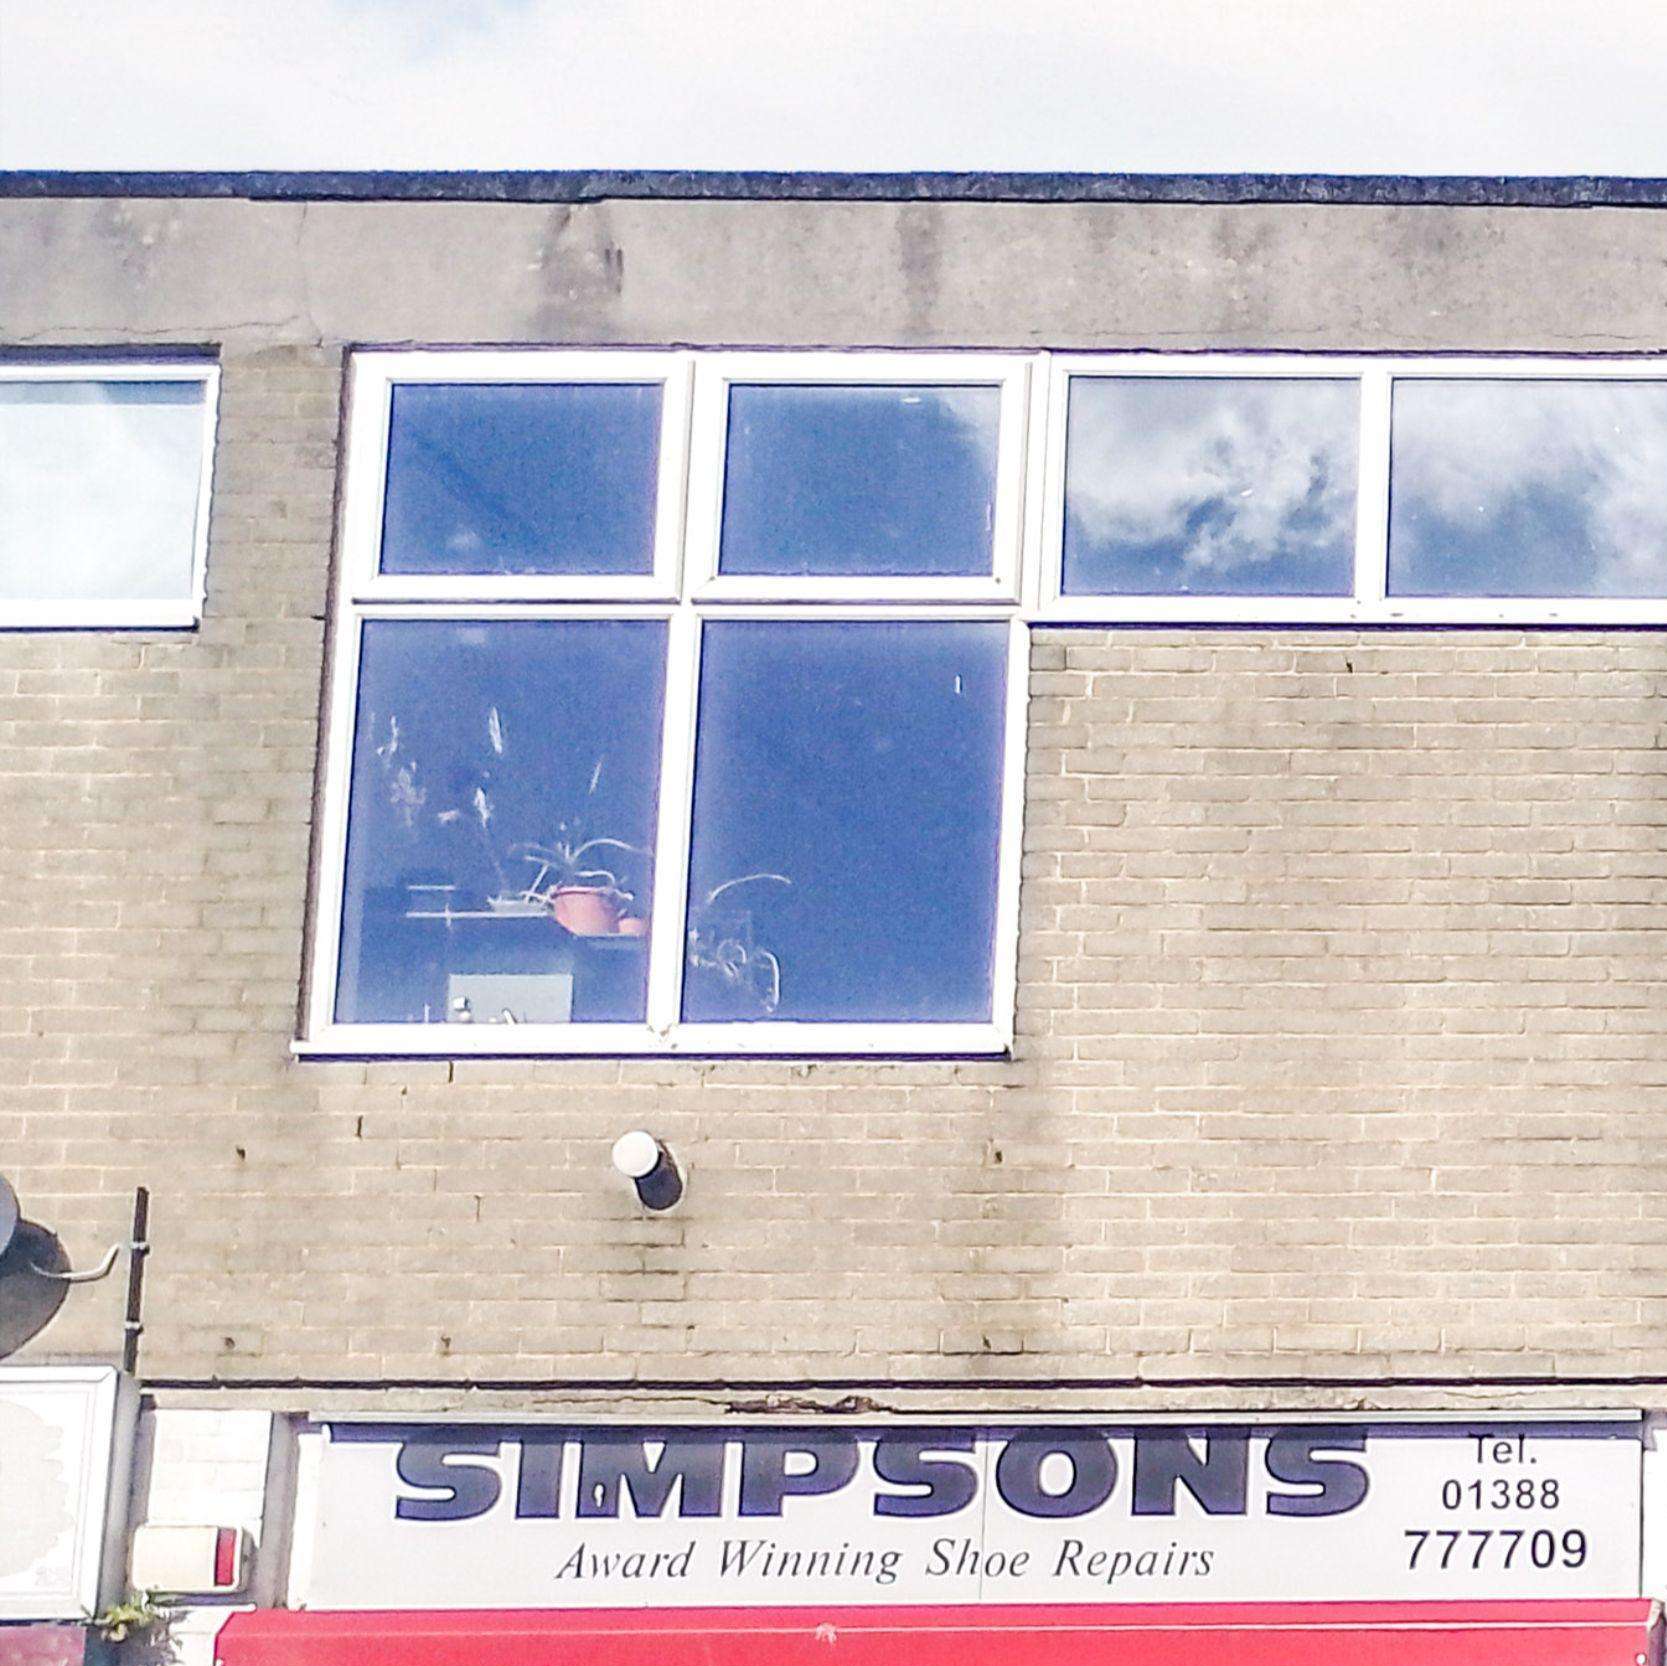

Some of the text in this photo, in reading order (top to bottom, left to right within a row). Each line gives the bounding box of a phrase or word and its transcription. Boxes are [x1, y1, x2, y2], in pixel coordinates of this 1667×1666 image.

[1467, 1433, 1537, 1464] Tel.
[395, 1426, 1373, 1522] SIMPSONS
[1442, 1478, 1560, 1510] 01388
[555, 1537, 1215, 1585] Award Winning Shoe Repairs
[1404, 1528, 1588, 1569] 777709
